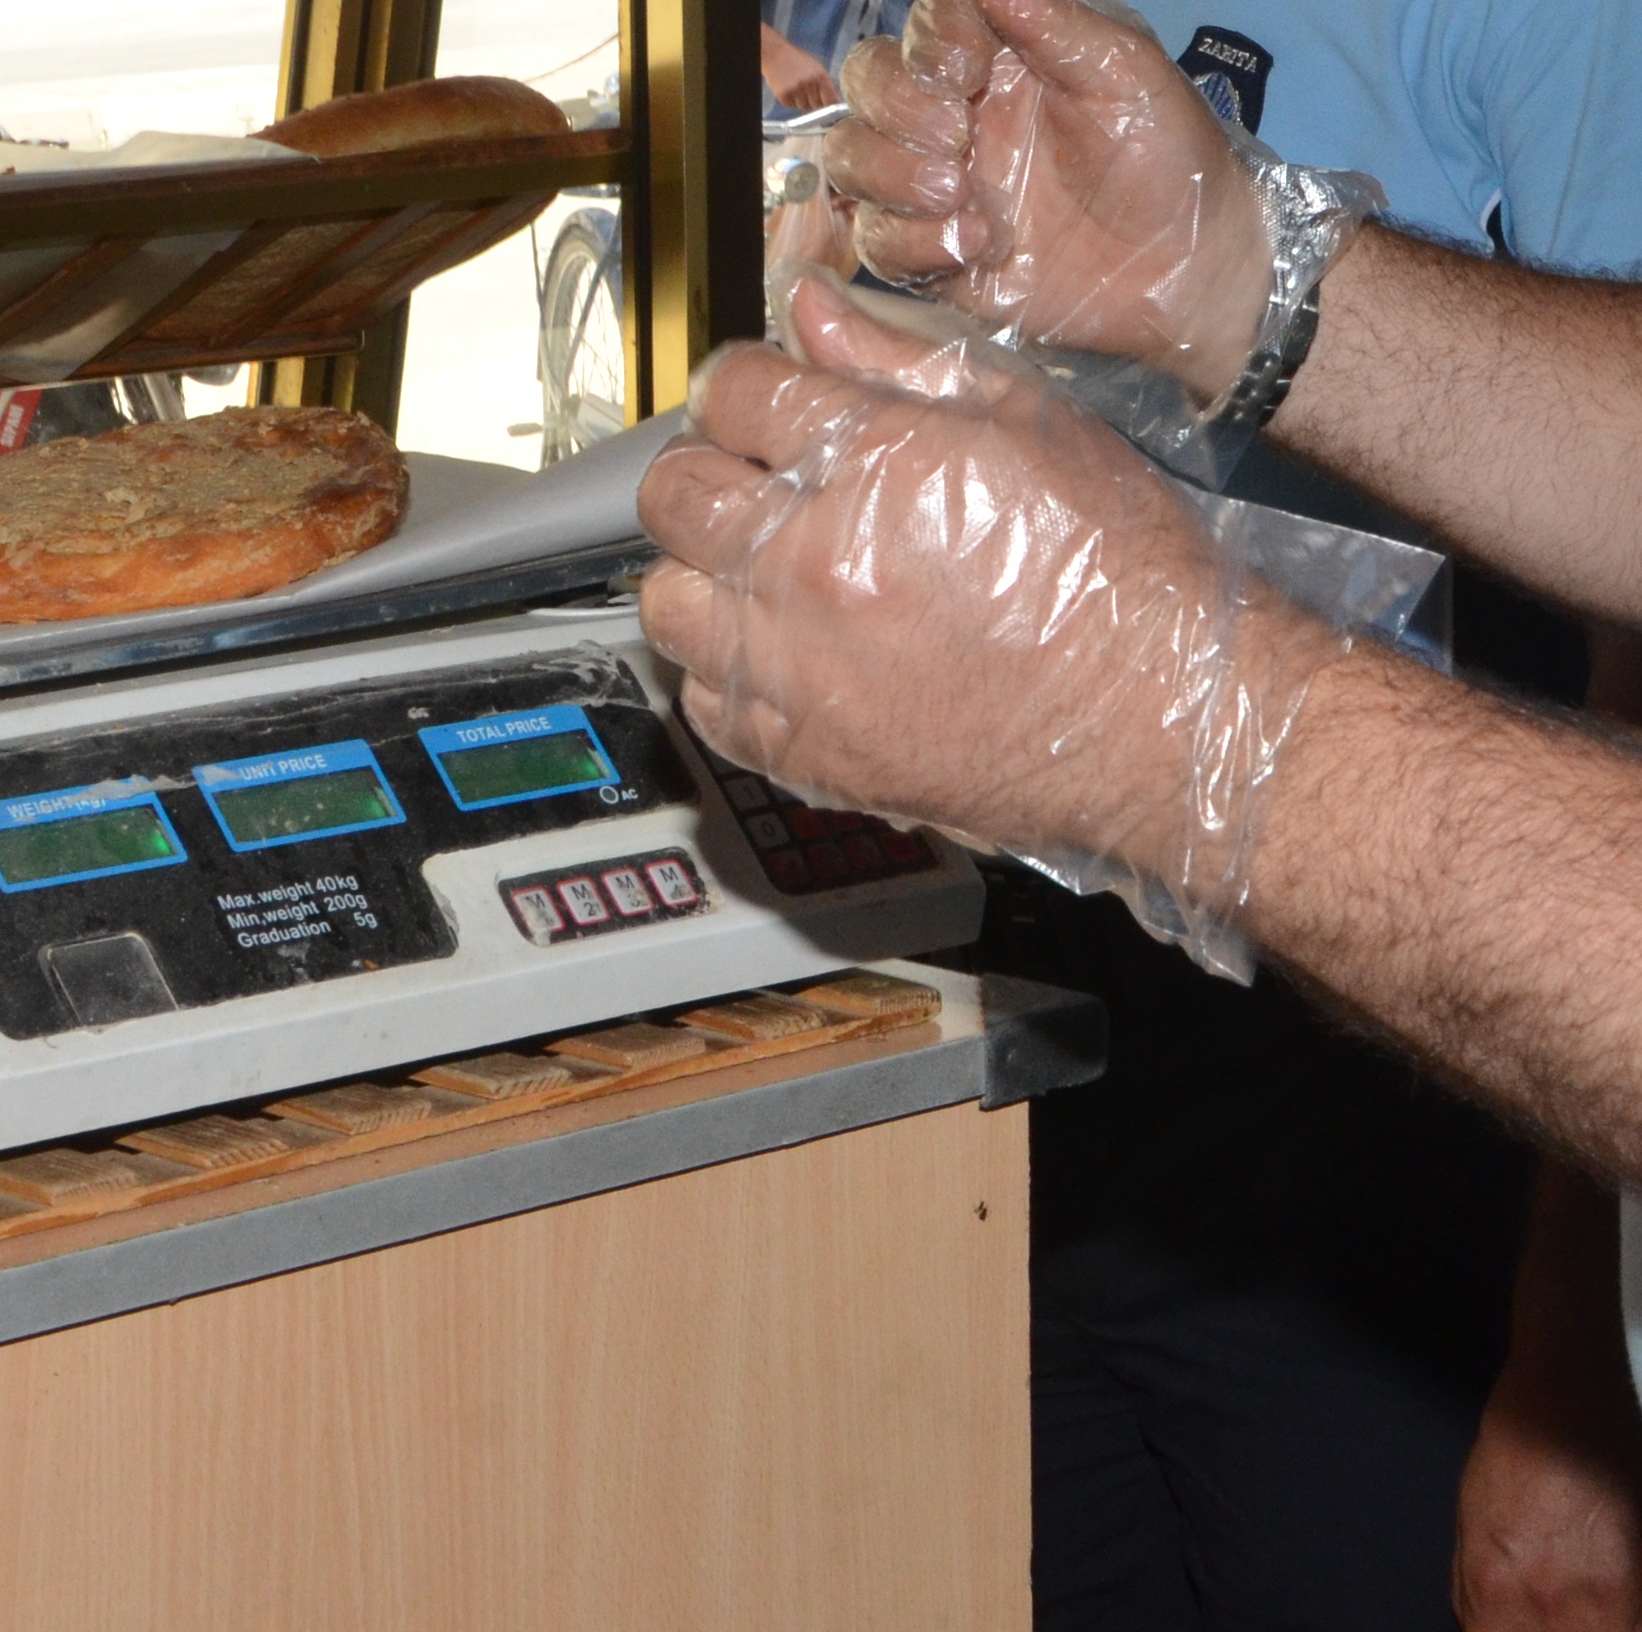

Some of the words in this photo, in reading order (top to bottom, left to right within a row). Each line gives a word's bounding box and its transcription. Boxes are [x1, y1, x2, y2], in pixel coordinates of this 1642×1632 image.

[455, 724, 505, 744] TOTAL
[506, 716, 551, 737] PRICE
[238, 761, 277, 780] UNIT
[278, 754, 327, 775] PRICE
[621, 788, 638, 801] AC
[615, 875, 635, 890] M
[658, 866, 679, 882] M
[217, 881, 315, 911] Max.weight
[316, 875, 359, 893] 40kg
[571, 884, 589, 901] M
[323, 893, 369, 911] 200g
[583, 902, 596, 917] 2
[237, 920, 332, 948] Graduation
[352, 911, 379, 929] 5g
